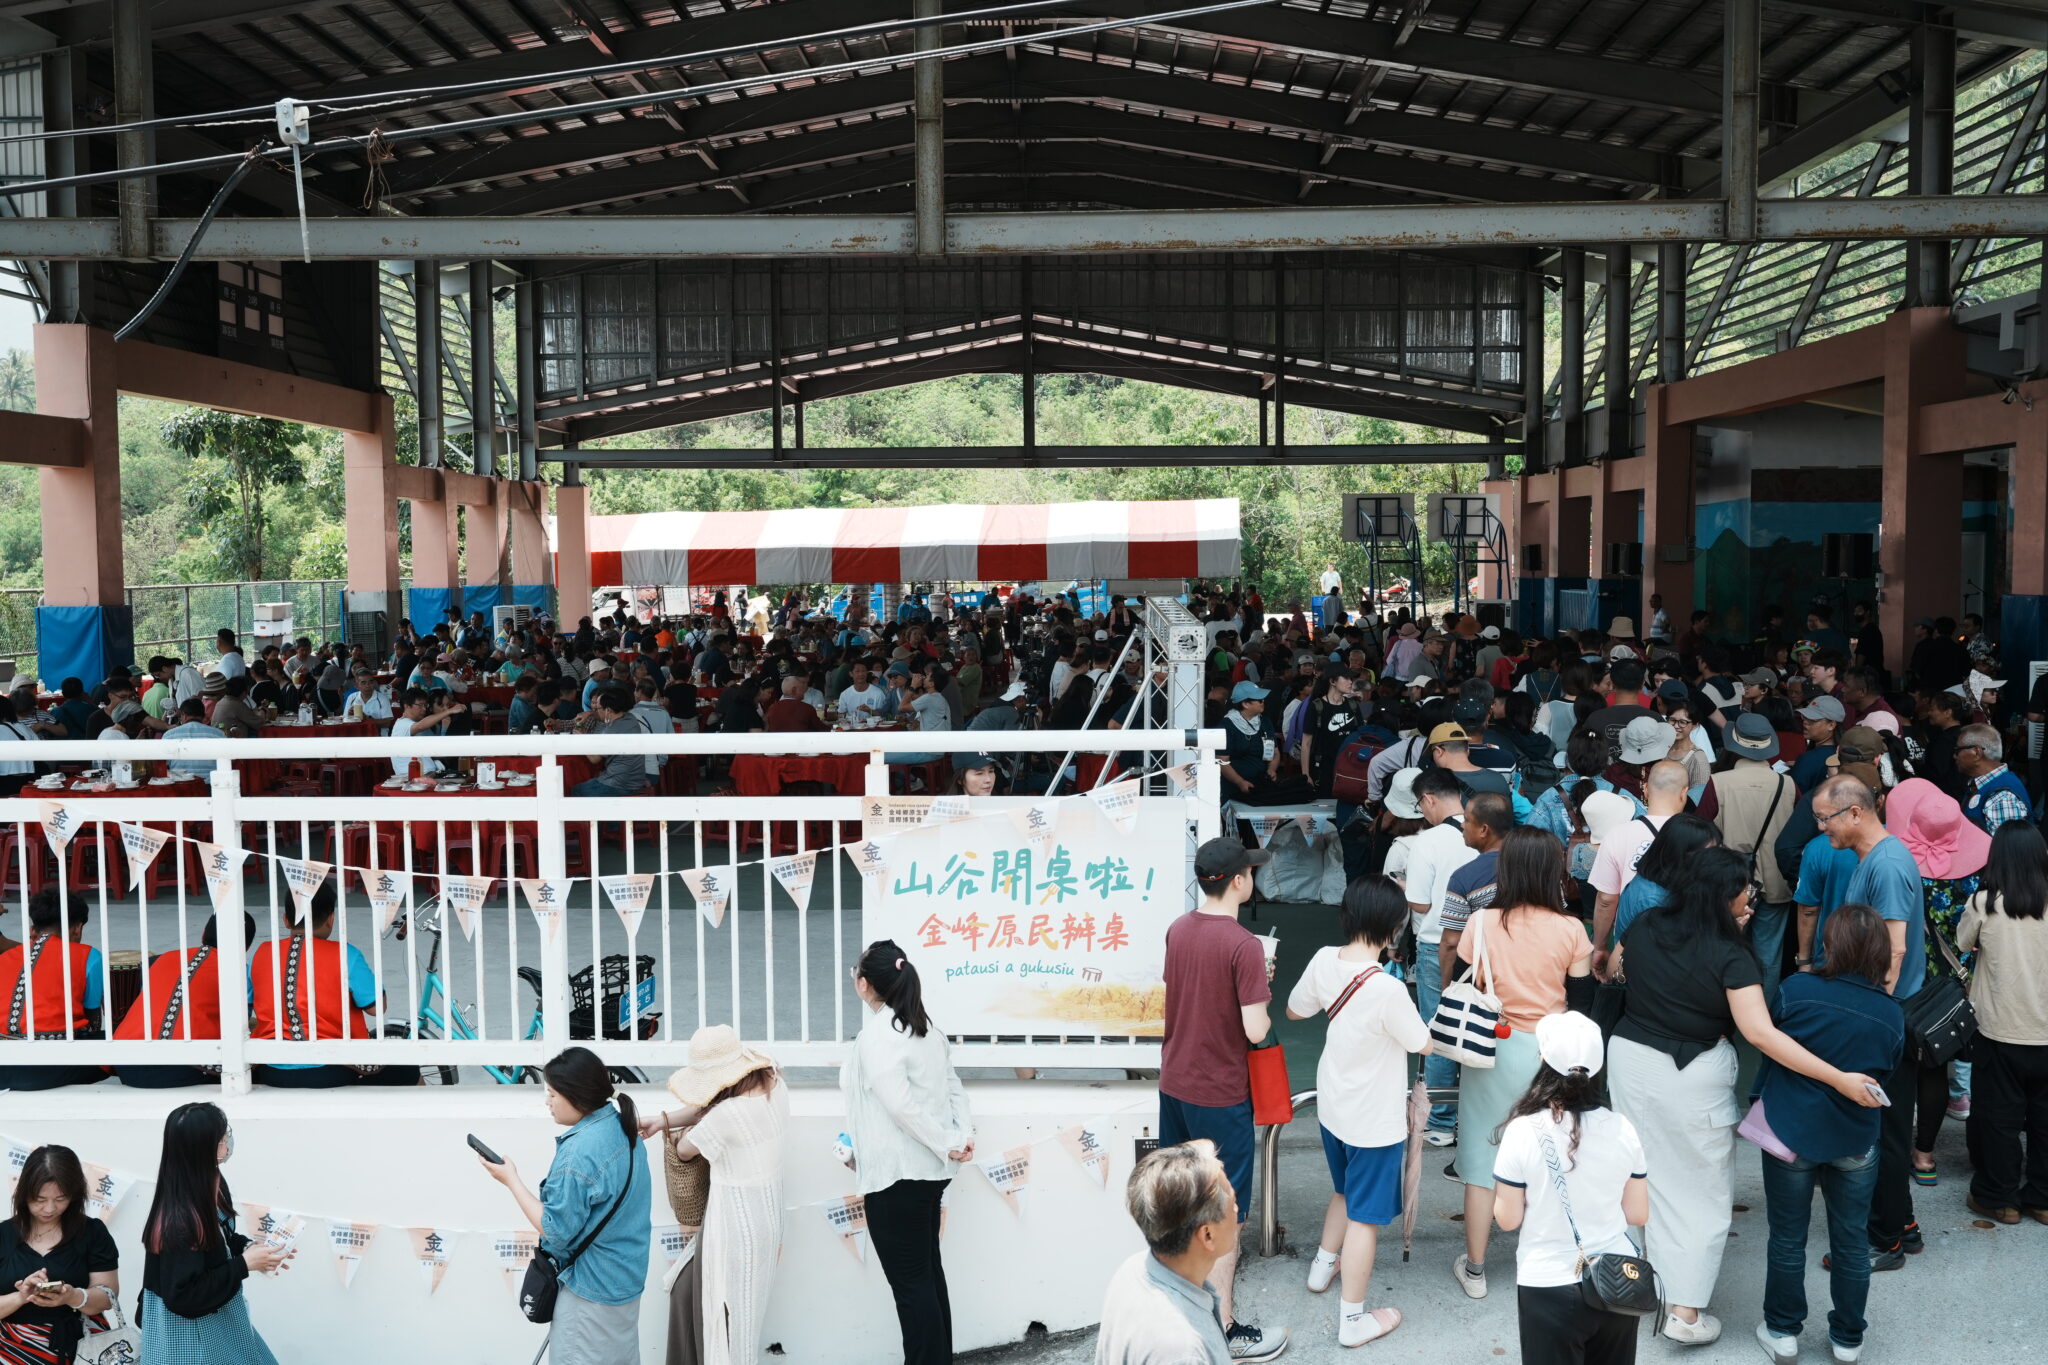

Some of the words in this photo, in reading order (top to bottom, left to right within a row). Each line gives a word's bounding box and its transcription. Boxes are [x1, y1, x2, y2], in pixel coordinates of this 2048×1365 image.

[49, 808, 69, 831] 金
[871, 803, 883, 817] 金
[1026, 807, 1047, 829] 金
[211, 850, 229, 871] 金
[862, 841, 882, 863] 金
[376, 874, 395, 893] 金
[537, 882, 556, 904] 金
[700, 872, 720, 894] 金
[945, 961, 1000, 981] patausi
[1005, 962, 1014, 973] a
[1019, 959, 1075, 978] gukusiu
[1078, 1129, 1100, 1153] 金
[96, 1174, 115, 1196] 金
[257, 1212, 276, 1234] 金
[827, 1204, 864, 1220] 金峰鄉原生藝
[424, 1232, 443, 1253] 金
